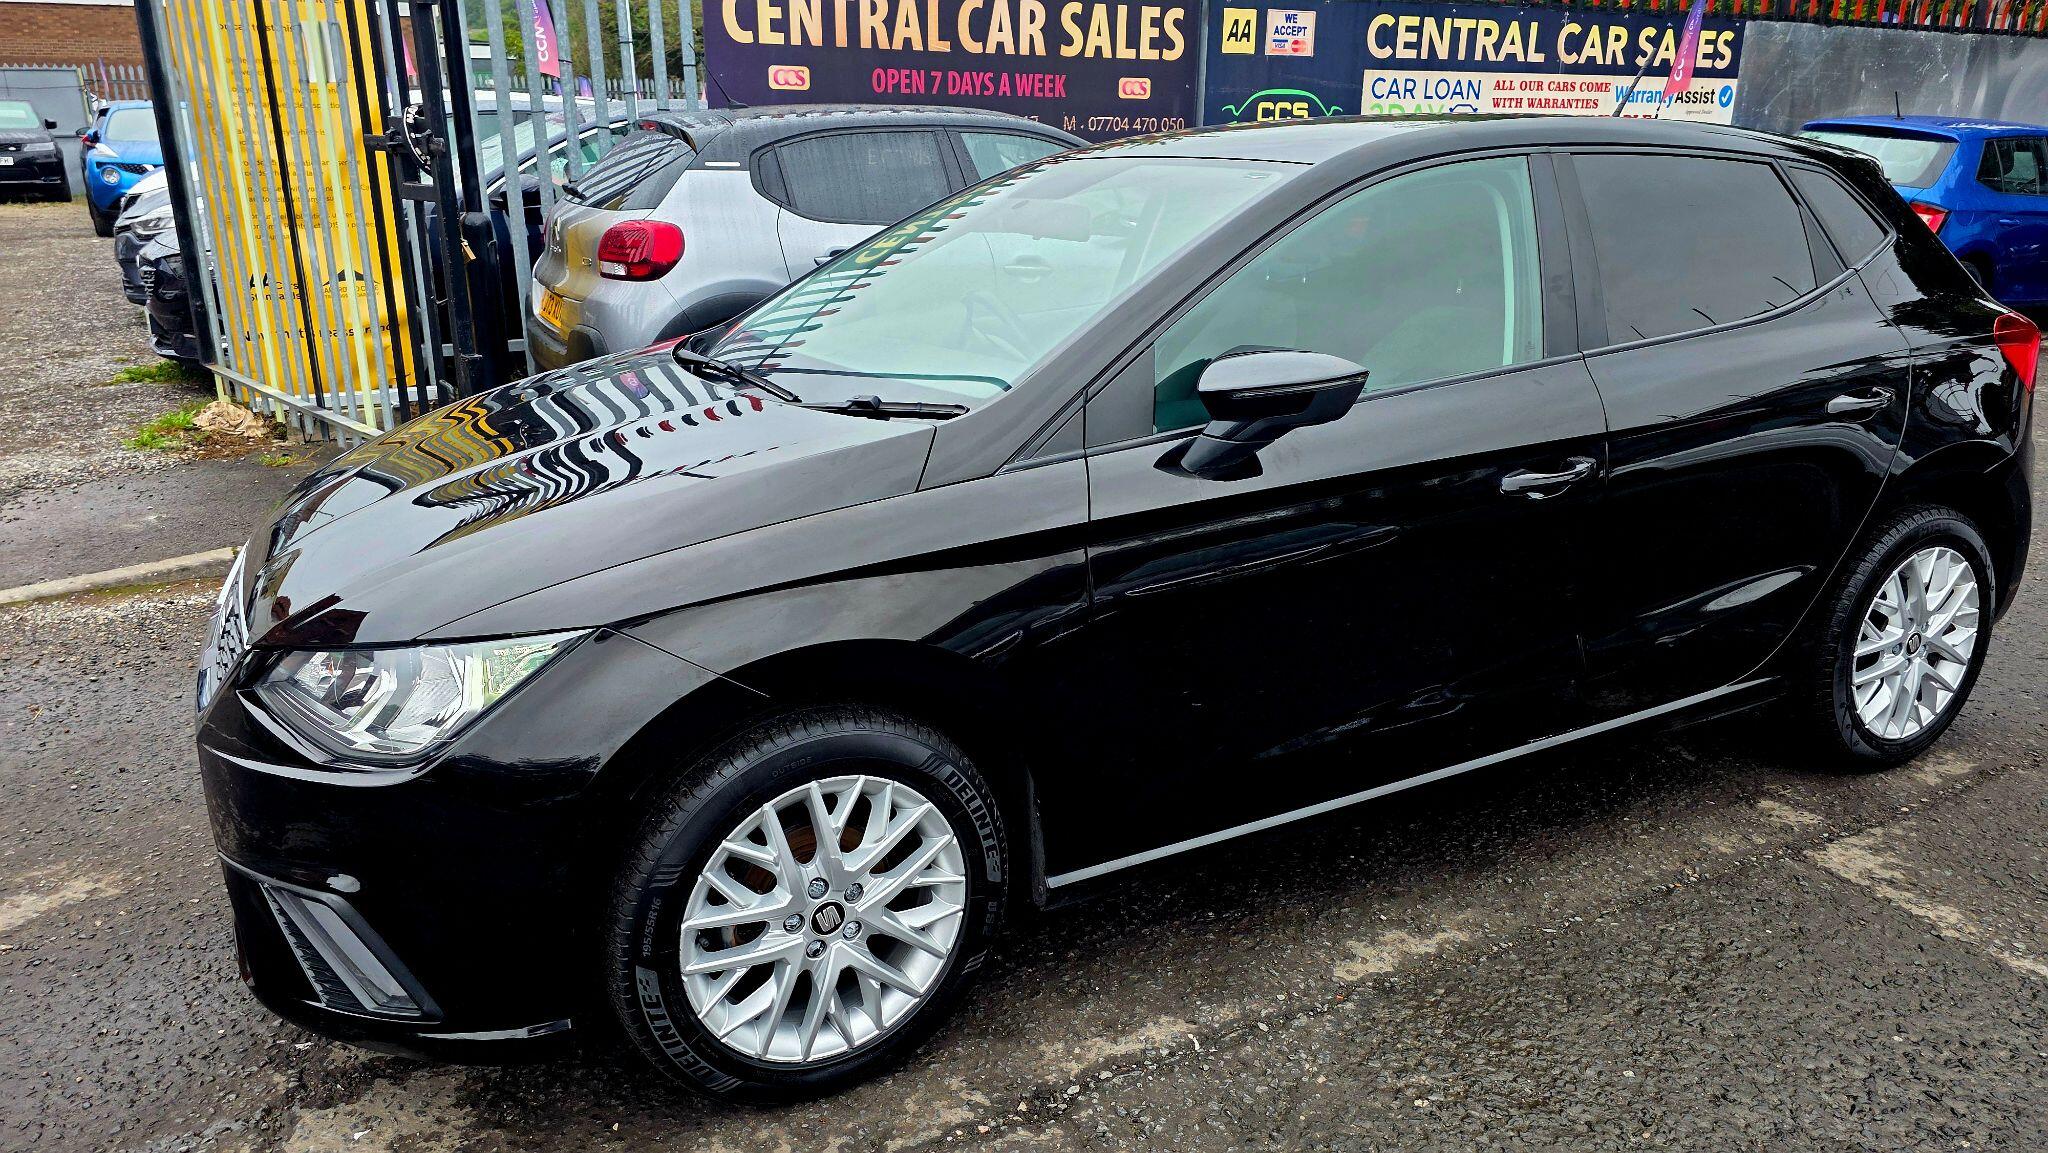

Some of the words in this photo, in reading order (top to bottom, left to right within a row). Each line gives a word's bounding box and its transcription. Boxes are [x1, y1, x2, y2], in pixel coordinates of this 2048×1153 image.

[722, 0, 951, 53] CENTRAL
[957, 0, 1047, 56] CAR
[1060, 1, 1185, 61] SALES
[1226, 18, 1252, 43] AA
[1284, 13, 1298, 24] WE
[1273, 26, 1308, 37] ACCEPT
[1366, 13, 1546, 63] CENTRAL
[1557, 22, 1628, 66] CAR
[1635, 26, 1735, 70] SAES
[872, 67, 925, 94] OPEN
[931, 70, 943, 95] 7
[948, 71, 995, 96] DAYS
[999, 73, 1011, 97] A
[1015, 73, 1067, 98] WEEK
[1371, 77, 1417, 100] CAR
[1423, 78, 1482, 101] LOAN
[1493, 80, 1515, 91] ALL
[1519, 81, 1544, 92] OUR
[1547, 81, 1576, 93] CARS
[1580, 82, 1612, 93] COME
[1257, 101, 1309, 121] CCS
[1492, 98, 1523, 109] WITH
[1527, 98, 1599, 110] WARRANTIES
[1088, 116, 1129, 132] 07704
[1132, 117, 1157, 132] 470
[1160, 117, 1185, 132] 050
[943, 769, 999, 859] DELINTE
[642, 898, 663, 957] 195/55R16
[641, 993, 712, 1081] DELINTE
